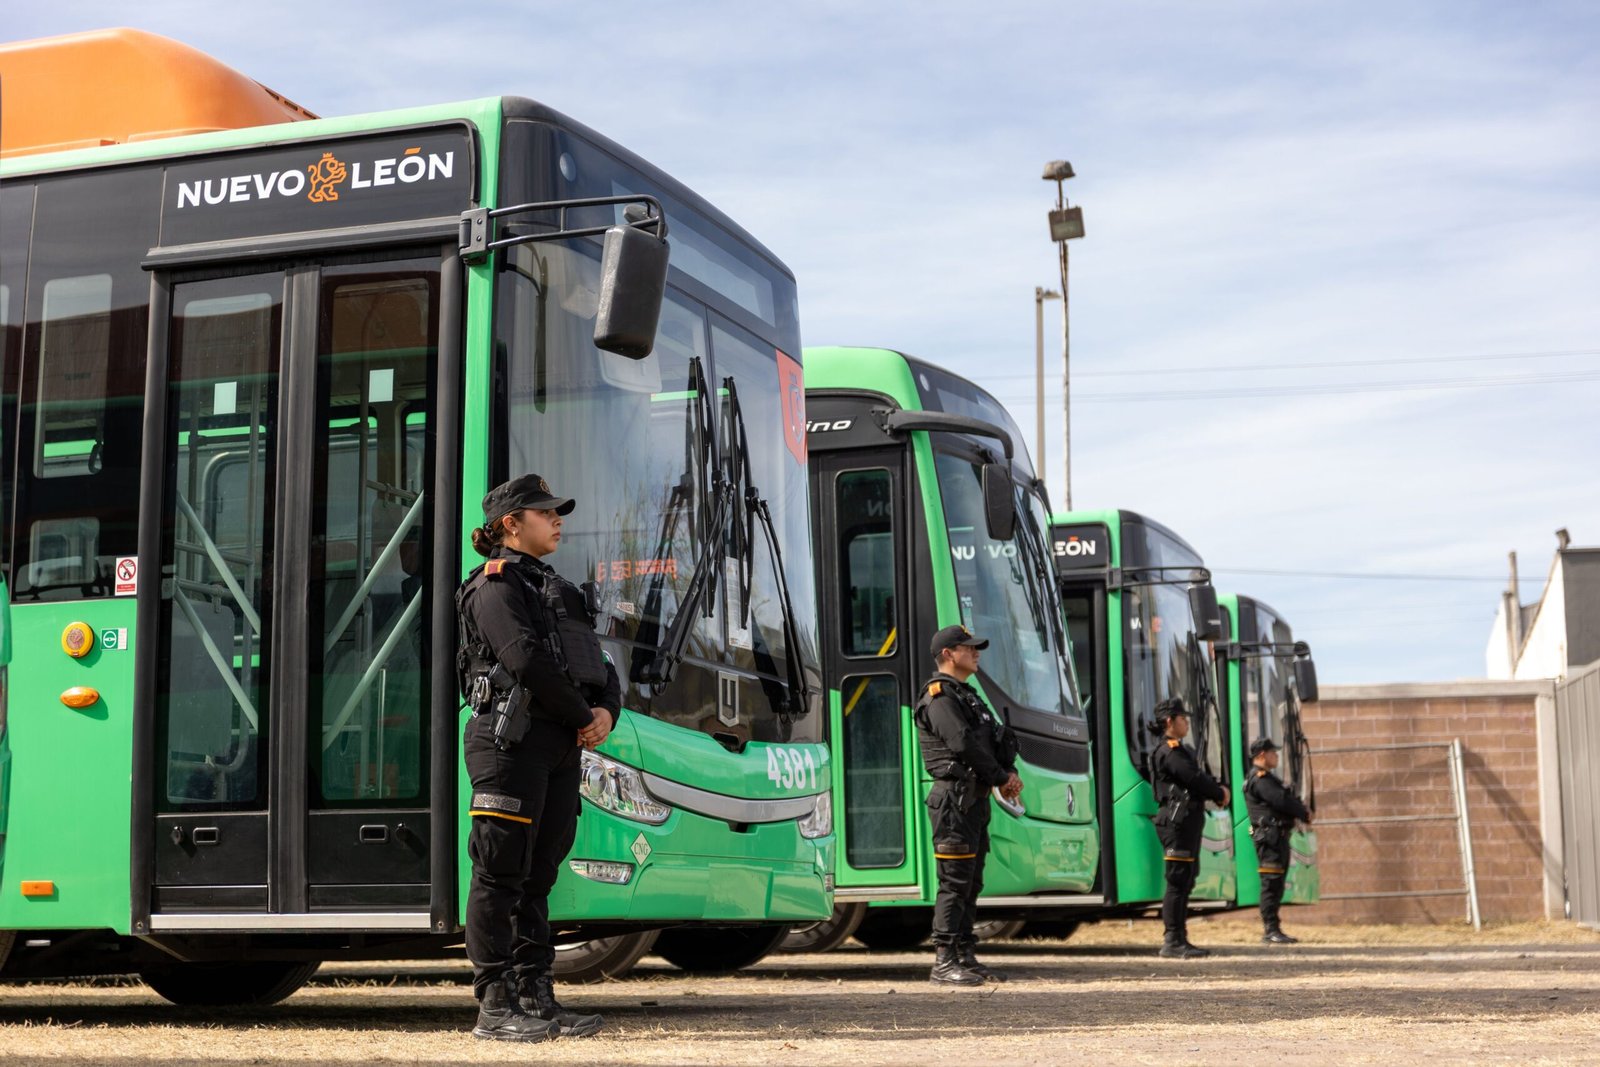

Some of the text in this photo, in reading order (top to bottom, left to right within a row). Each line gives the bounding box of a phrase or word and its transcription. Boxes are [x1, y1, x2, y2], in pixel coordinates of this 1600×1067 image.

[177, 146, 455, 209] NUEVO LEÓN
[951, 536, 1096, 561] NUVO EÓN
[765, 746, 816, 790] 4381
[634, 842, 649, 856] CNG
